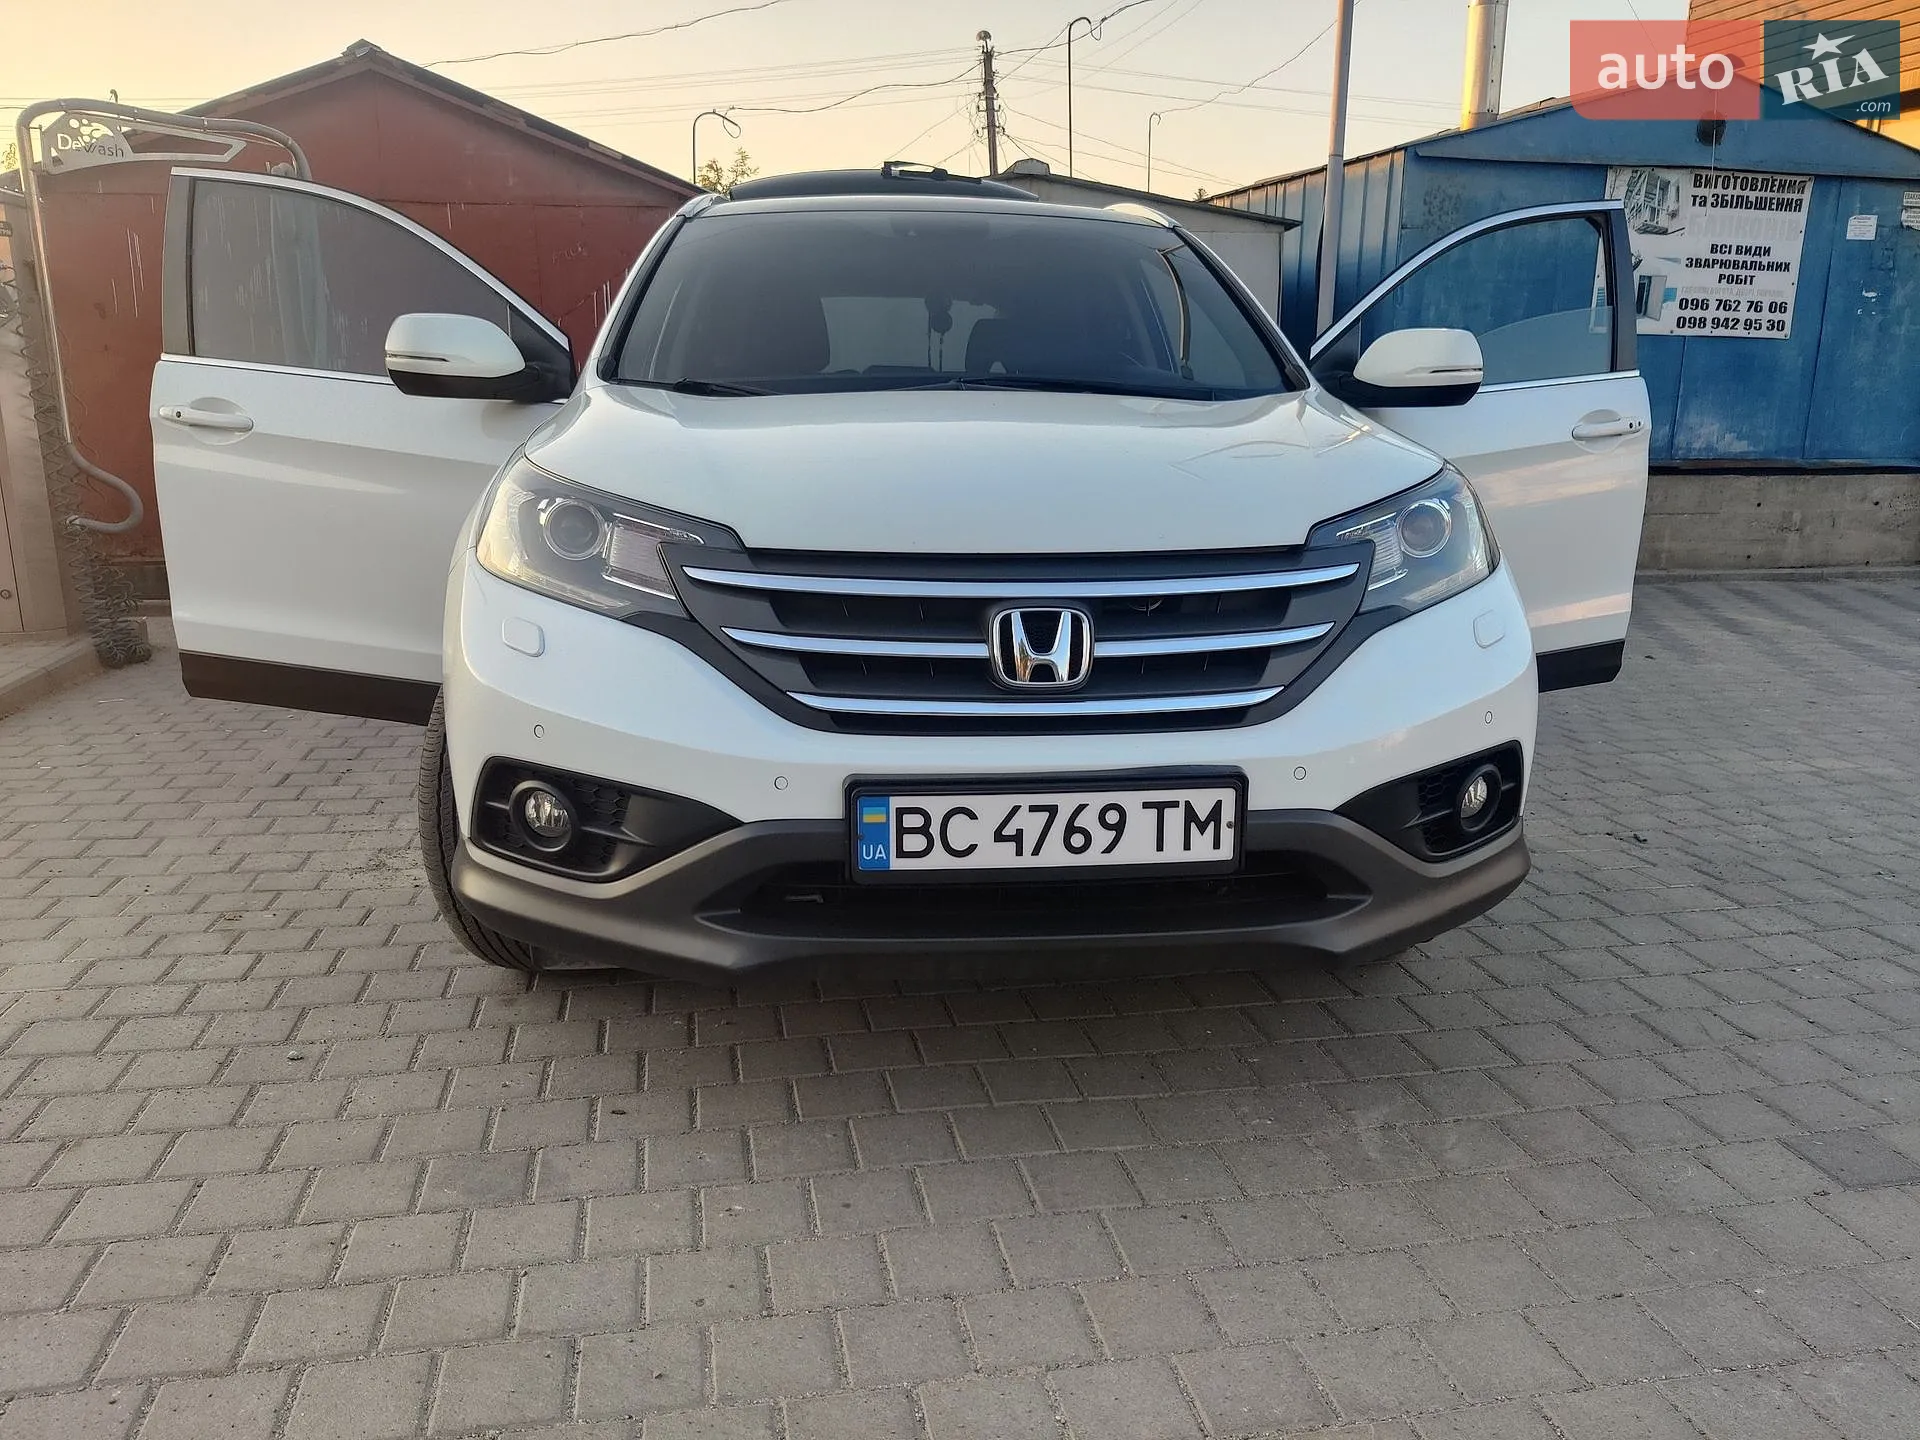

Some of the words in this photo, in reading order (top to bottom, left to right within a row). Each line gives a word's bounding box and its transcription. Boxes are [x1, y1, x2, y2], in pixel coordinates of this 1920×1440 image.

[1693, 173, 1807, 195] ВИГОТОВЛЕННЯ
[1691, 194, 1708, 208] та
[1710, 193, 1804, 213] ЗБІЛЬШЕННЯ
[1710, 243, 1733, 255] ВСІ
[1735, 245, 1771, 258] ВИДИ
[1685, 257, 1791, 273] ЗВАРЮВАЛЬНИХ
[1718, 273, 1756, 286] РОБІТ
[1678, 297, 1710, 311] 096
[1715, 299, 1741, 313] 762
[1746, 300, 1764, 313] 76
[1768, 301, 1788, 314] 06
[1676, 316, 1707, 329] 098
[1711, 317, 1740, 331] 942
[1743, 318, 1763, 331] 95
[1766, 319, 1786, 332] 30
[895, 806, 979, 859] BC
[993, 802, 1128, 857] 4769
[1142, 799, 1223, 852] TM
[862, 844, 887, 861] UA
